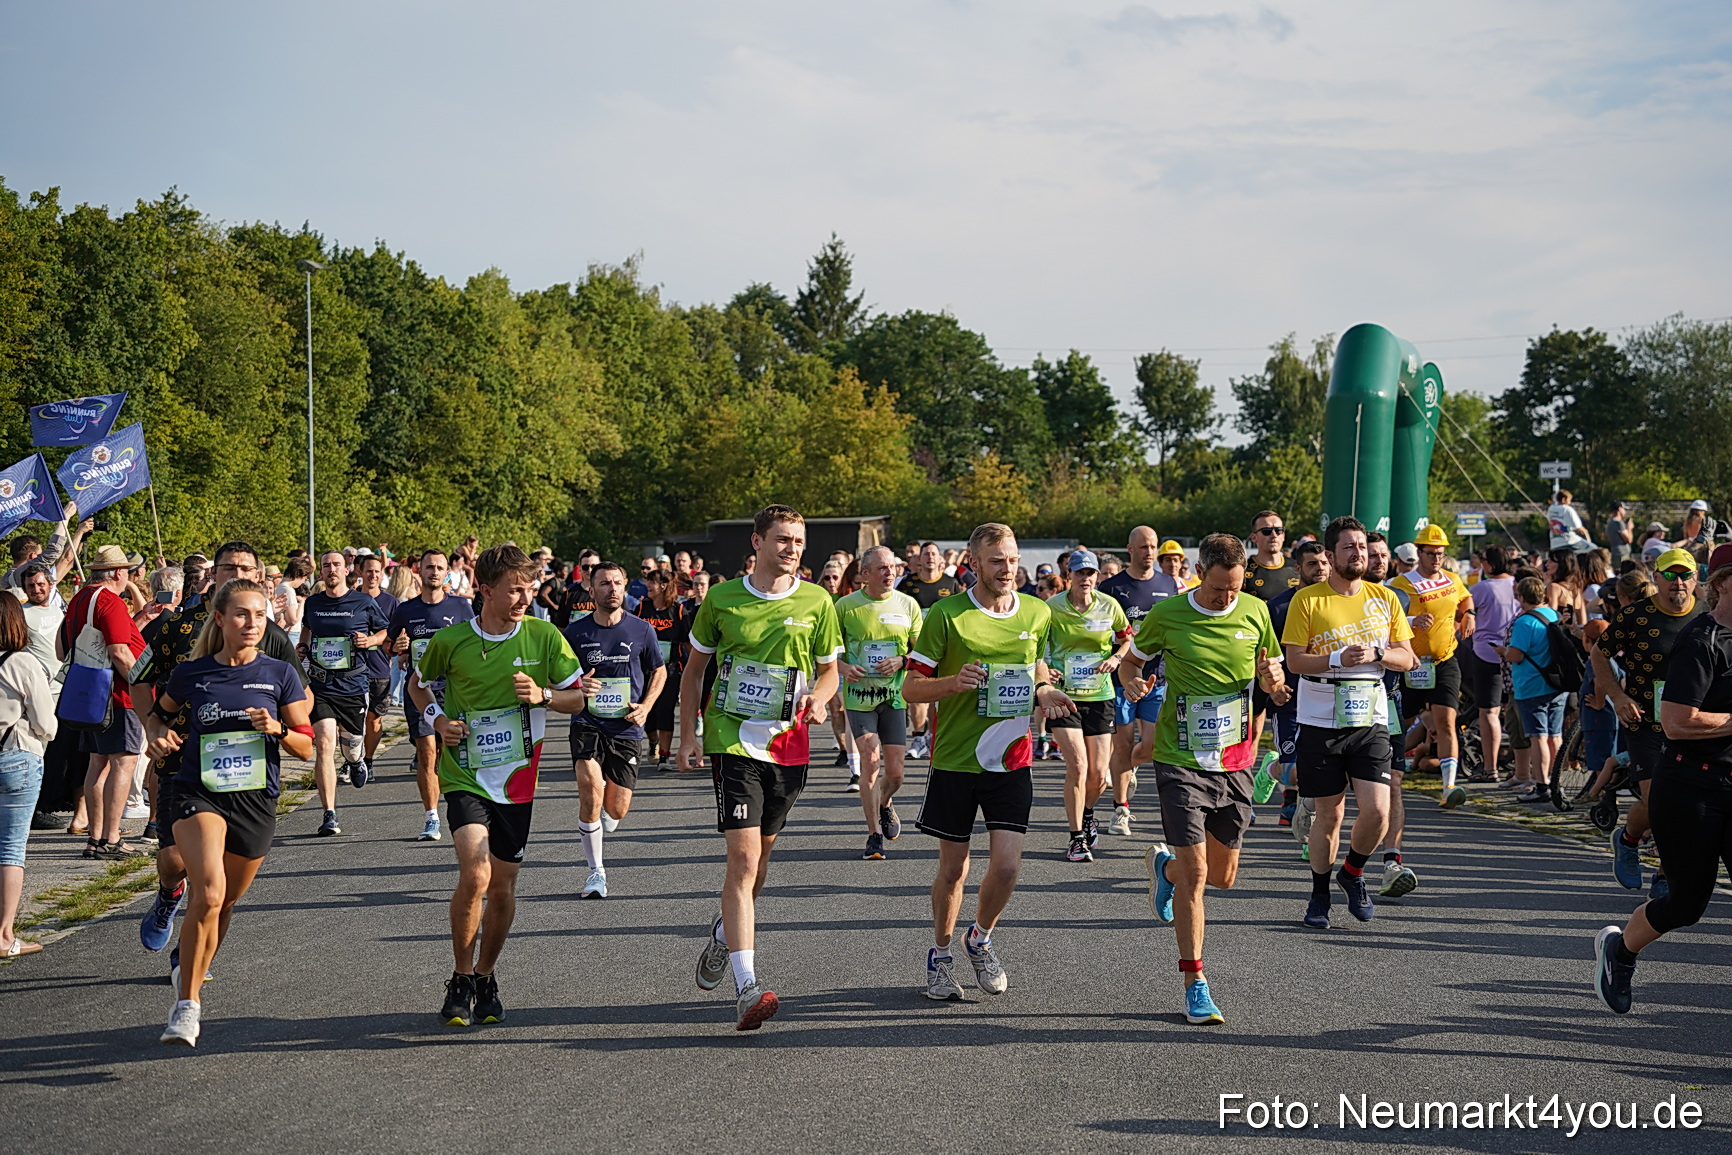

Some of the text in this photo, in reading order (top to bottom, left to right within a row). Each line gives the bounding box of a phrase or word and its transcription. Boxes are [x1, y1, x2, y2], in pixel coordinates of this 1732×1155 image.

[1419, 593, 1439, 604] MAX
[1310, 618, 1381, 649] SPANGLER
[1310, 627, 1389, 656] UTOMATION
[1072, 667, 1094, 675] 1380
[738, 682, 772, 698] 2677
[998, 686, 1030, 697] 2673
[595, 695, 622, 703] 2026
[1344, 700, 1369, 709] 2525
[1198, 716, 1231, 730] 2675
[476, 731, 512, 746] 2680
[212, 756, 252, 770] 2055
[733, 803, 748, 820] 41
